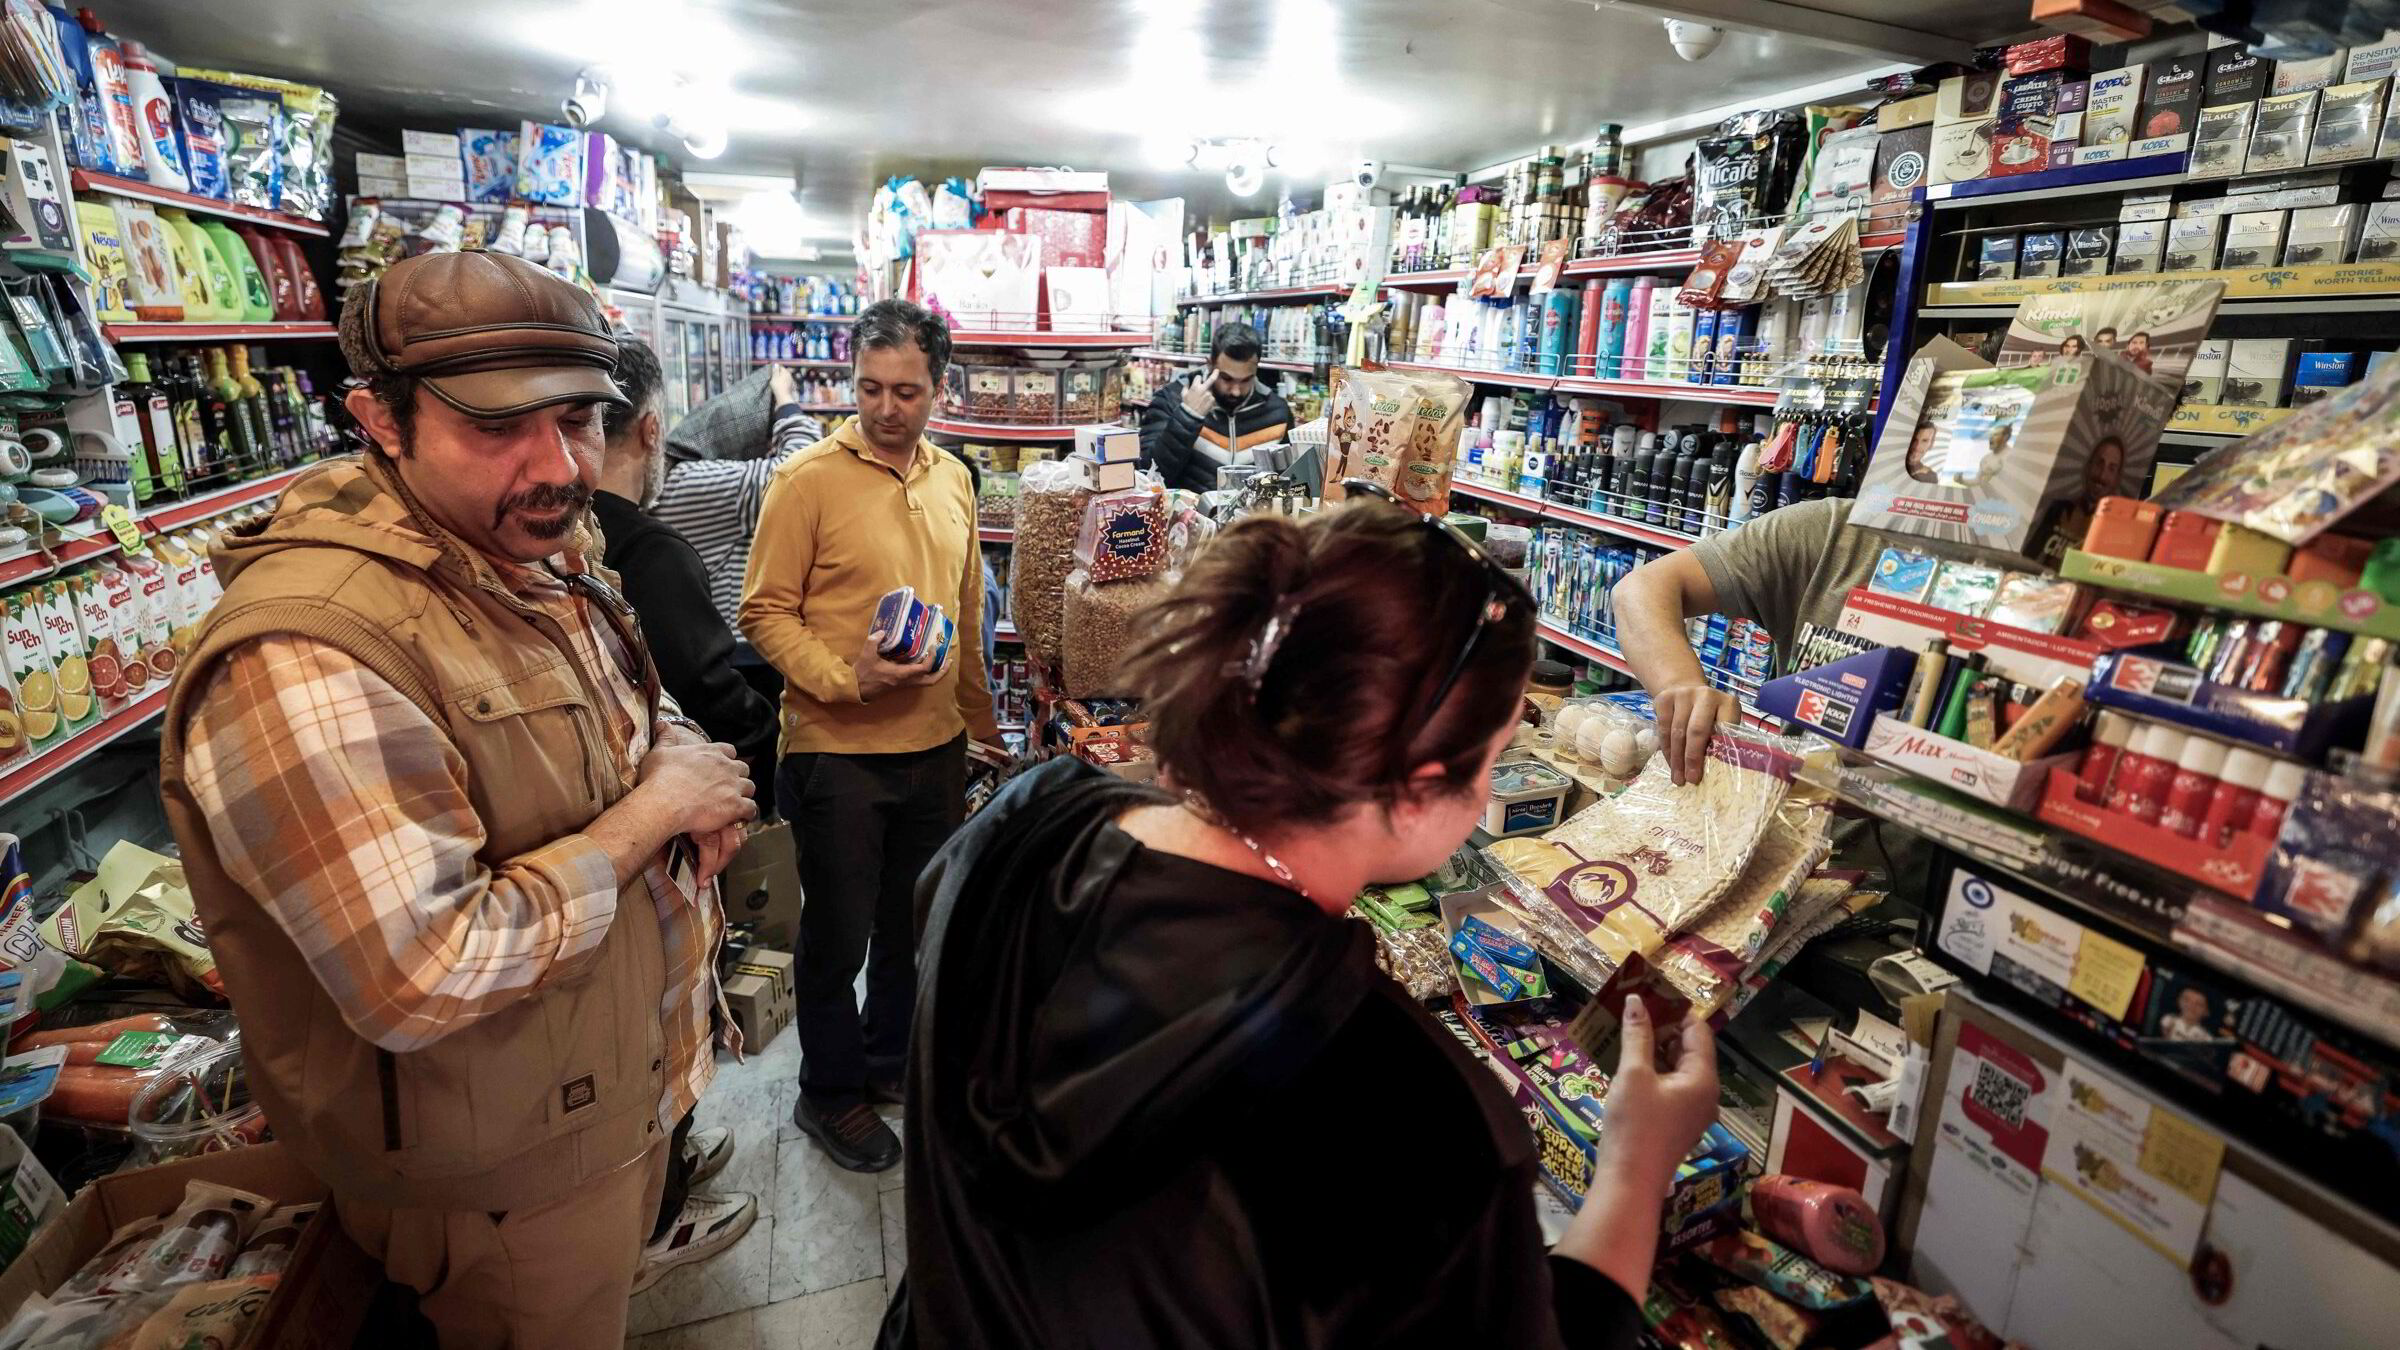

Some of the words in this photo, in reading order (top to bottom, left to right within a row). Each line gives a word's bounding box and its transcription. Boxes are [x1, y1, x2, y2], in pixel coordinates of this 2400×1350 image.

[2352, 47, 2400, 62] SENSITIV
[2093, 75, 2126, 91] KODEX
[2016, 101, 2044, 110] GUSTO
[2091, 94, 2123, 107] MASTER
[2261, 102, 2296, 114] BLAKE
[2202, 112, 2234, 123] BLAKE
[2381, 215, 2400, 225] Wins
[2250, 271, 2300, 283] CAMEL
[2315, 360, 2346, 370] Winston
[2175, 411, 2200, 422] ON
[1112, 527, 1146, 539] Farmand
[83, 603, 101, 617] Sun
[45, 615, 64, 630] Sun
[1848, 613, 1861, 625] 24
[7, 628, 31, 645] Sun
[1795, 676, 1832, 694] ELECTRONIC
[1832, 689, 1860, 704] LIGHTER
[1825, 706, 1849, 721] KKK
[1892, 736, 1944, 759] Max
[61, 917, 77, 955] PREMIUM
